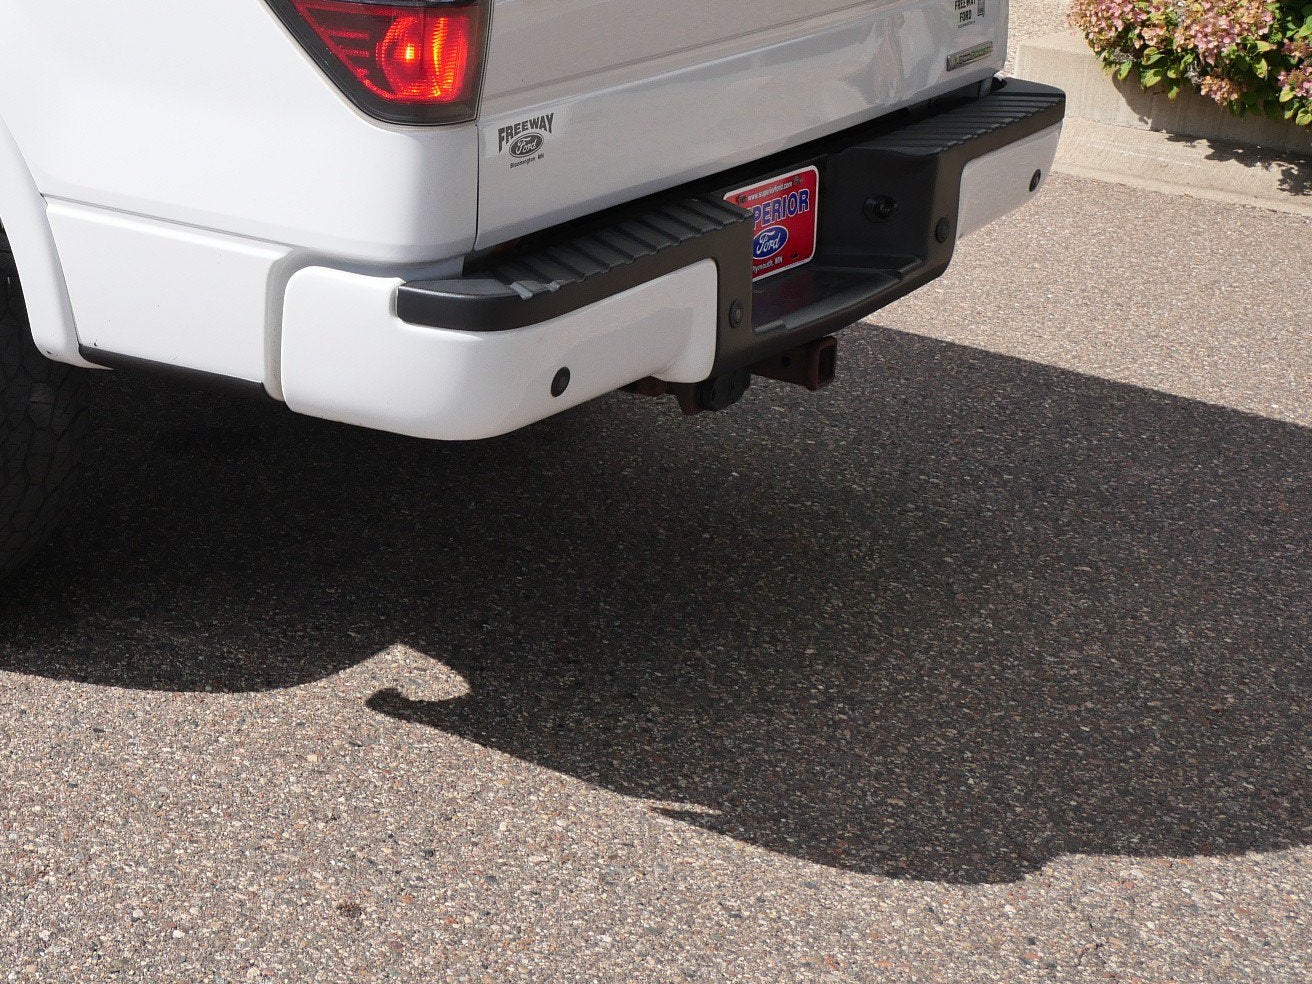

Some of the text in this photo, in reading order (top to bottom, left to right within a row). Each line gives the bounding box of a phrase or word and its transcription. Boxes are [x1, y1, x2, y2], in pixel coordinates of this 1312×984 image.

[959, 9, 973, 23] FORD
[497, 112, 555, 154] FREEWAY
[515, 136, 538, 155] Ford
[747, 188, 810, 230] PERIOR
[756, 230, 781, 255] Ford
